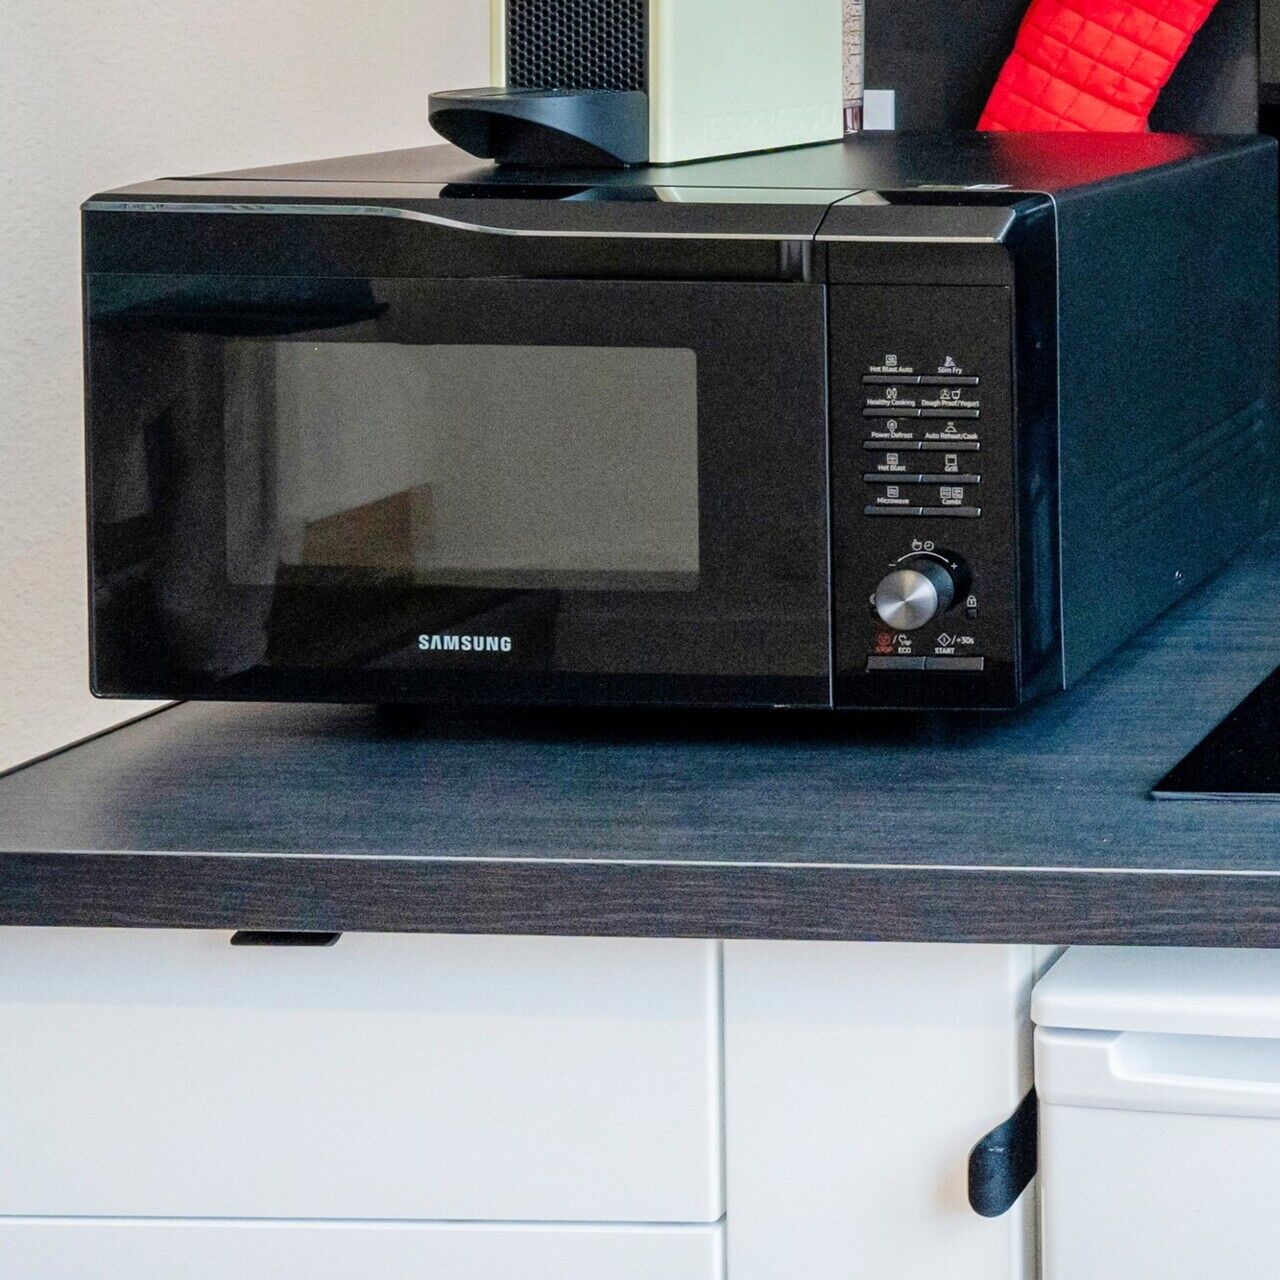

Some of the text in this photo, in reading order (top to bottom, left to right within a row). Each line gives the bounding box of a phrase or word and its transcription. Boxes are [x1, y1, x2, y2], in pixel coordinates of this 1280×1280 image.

[952, 367, 963, 375] Fry
[867, 399, 916, 407] Healthy Cooking
[921, 400, 940, 408] Dough
[871, 431, 913, 439] Power Defrost
[418, 634, 512, 651] SAMSUNG
